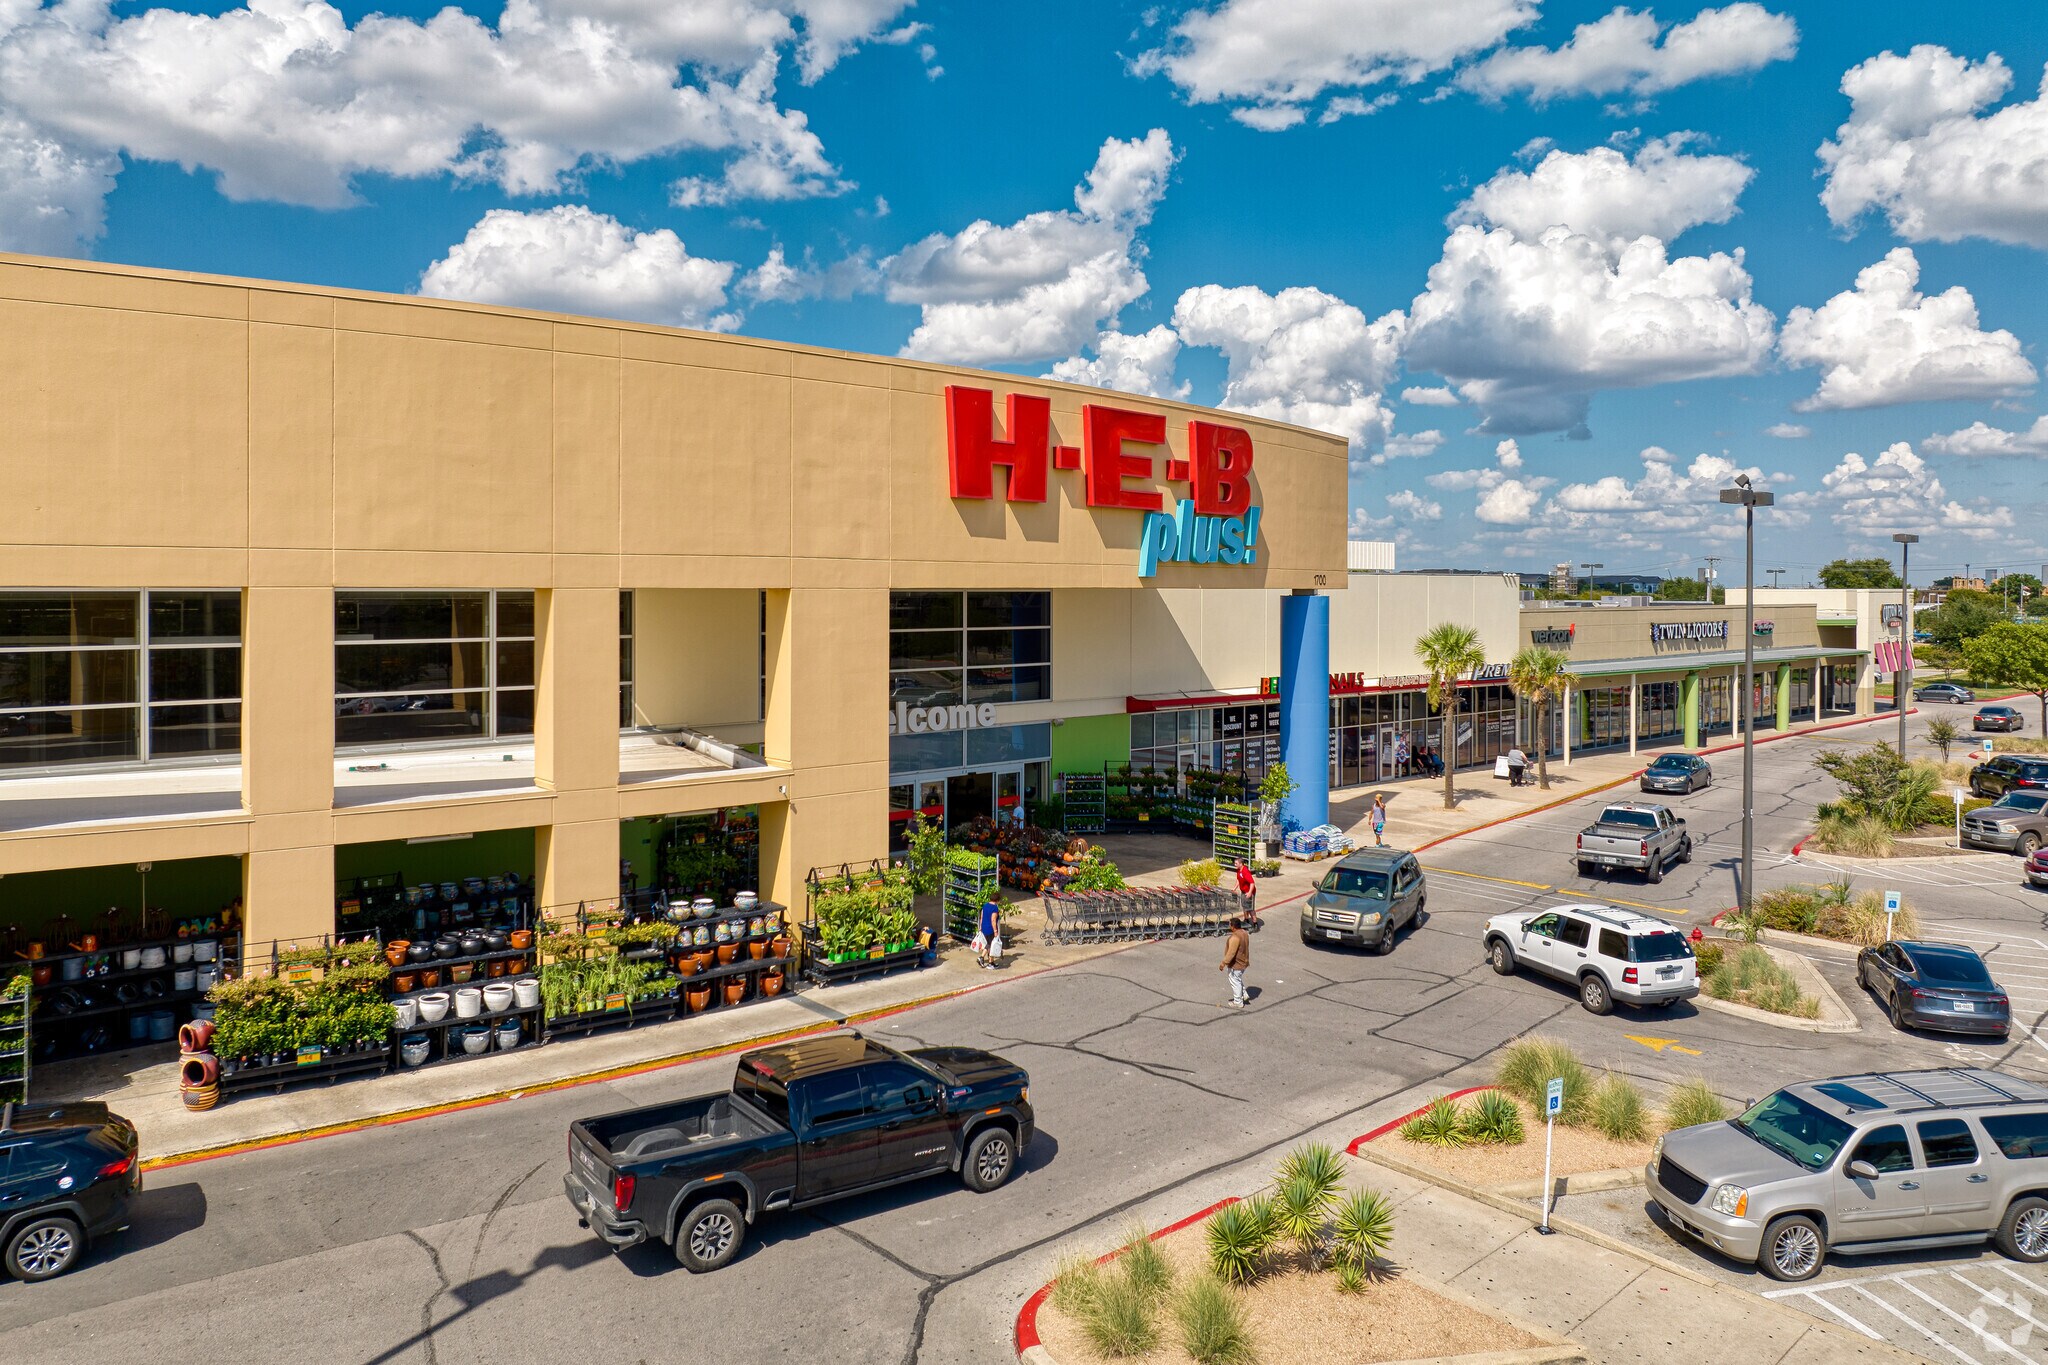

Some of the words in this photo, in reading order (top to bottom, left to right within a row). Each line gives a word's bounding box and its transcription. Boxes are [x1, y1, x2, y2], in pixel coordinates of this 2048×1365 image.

[945, 385, 1254, 515] H-E-B
[1138, 499, 1260, 578] plus!
[1313, 574, 1327, 586] 1700
[1531, 625, 1572, 644] verizon
[1659, 623, 1686, 641] TWIN
[1687, 621, 1724, 641] LIQUORS
[1472, 662, 1511, 681] PREM
[1261, 677, 1280, 695] BE
[1329, 672, 1364, 689] NAILS
[889, 701, 997, 733] lcome
